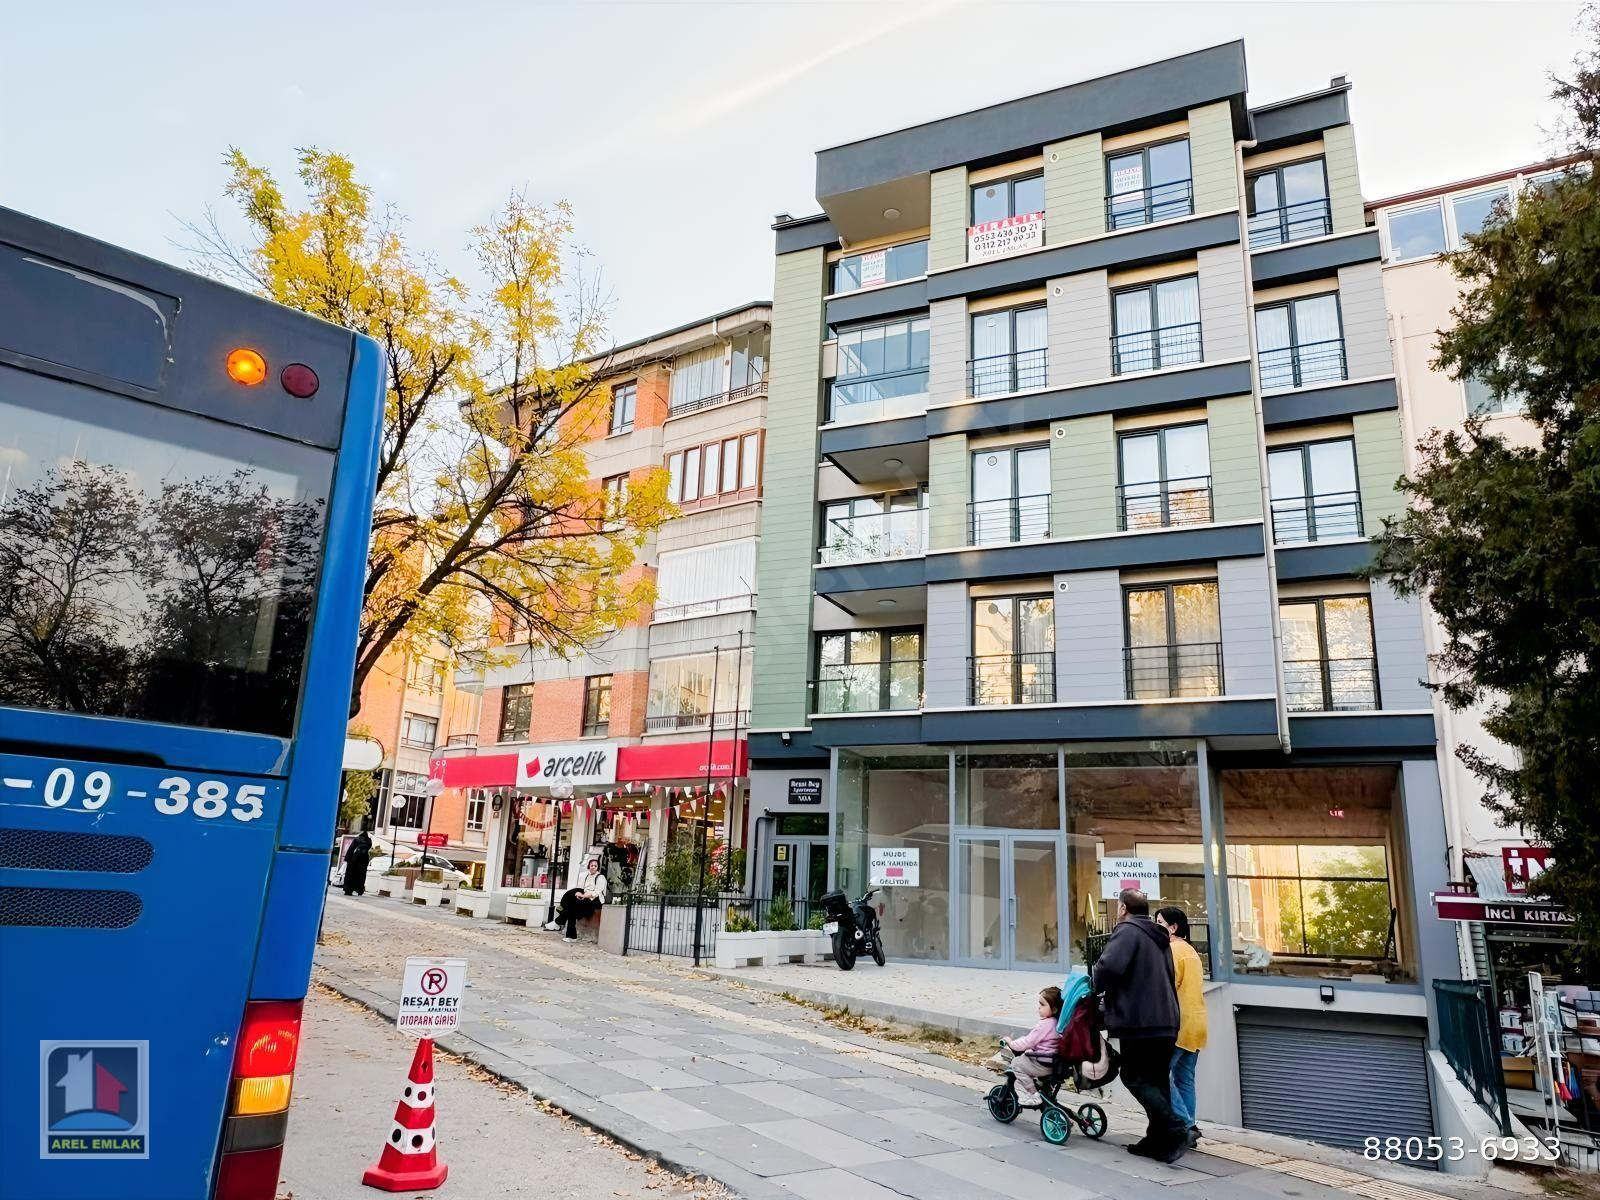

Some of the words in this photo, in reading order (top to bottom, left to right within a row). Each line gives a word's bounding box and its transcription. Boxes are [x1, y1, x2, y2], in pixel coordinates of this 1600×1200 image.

[402, 996, 436, 1009] REŞAT
[438, 997, 459, 1007] BEY
[400, 1015, 434, 1026] OTOPARK
